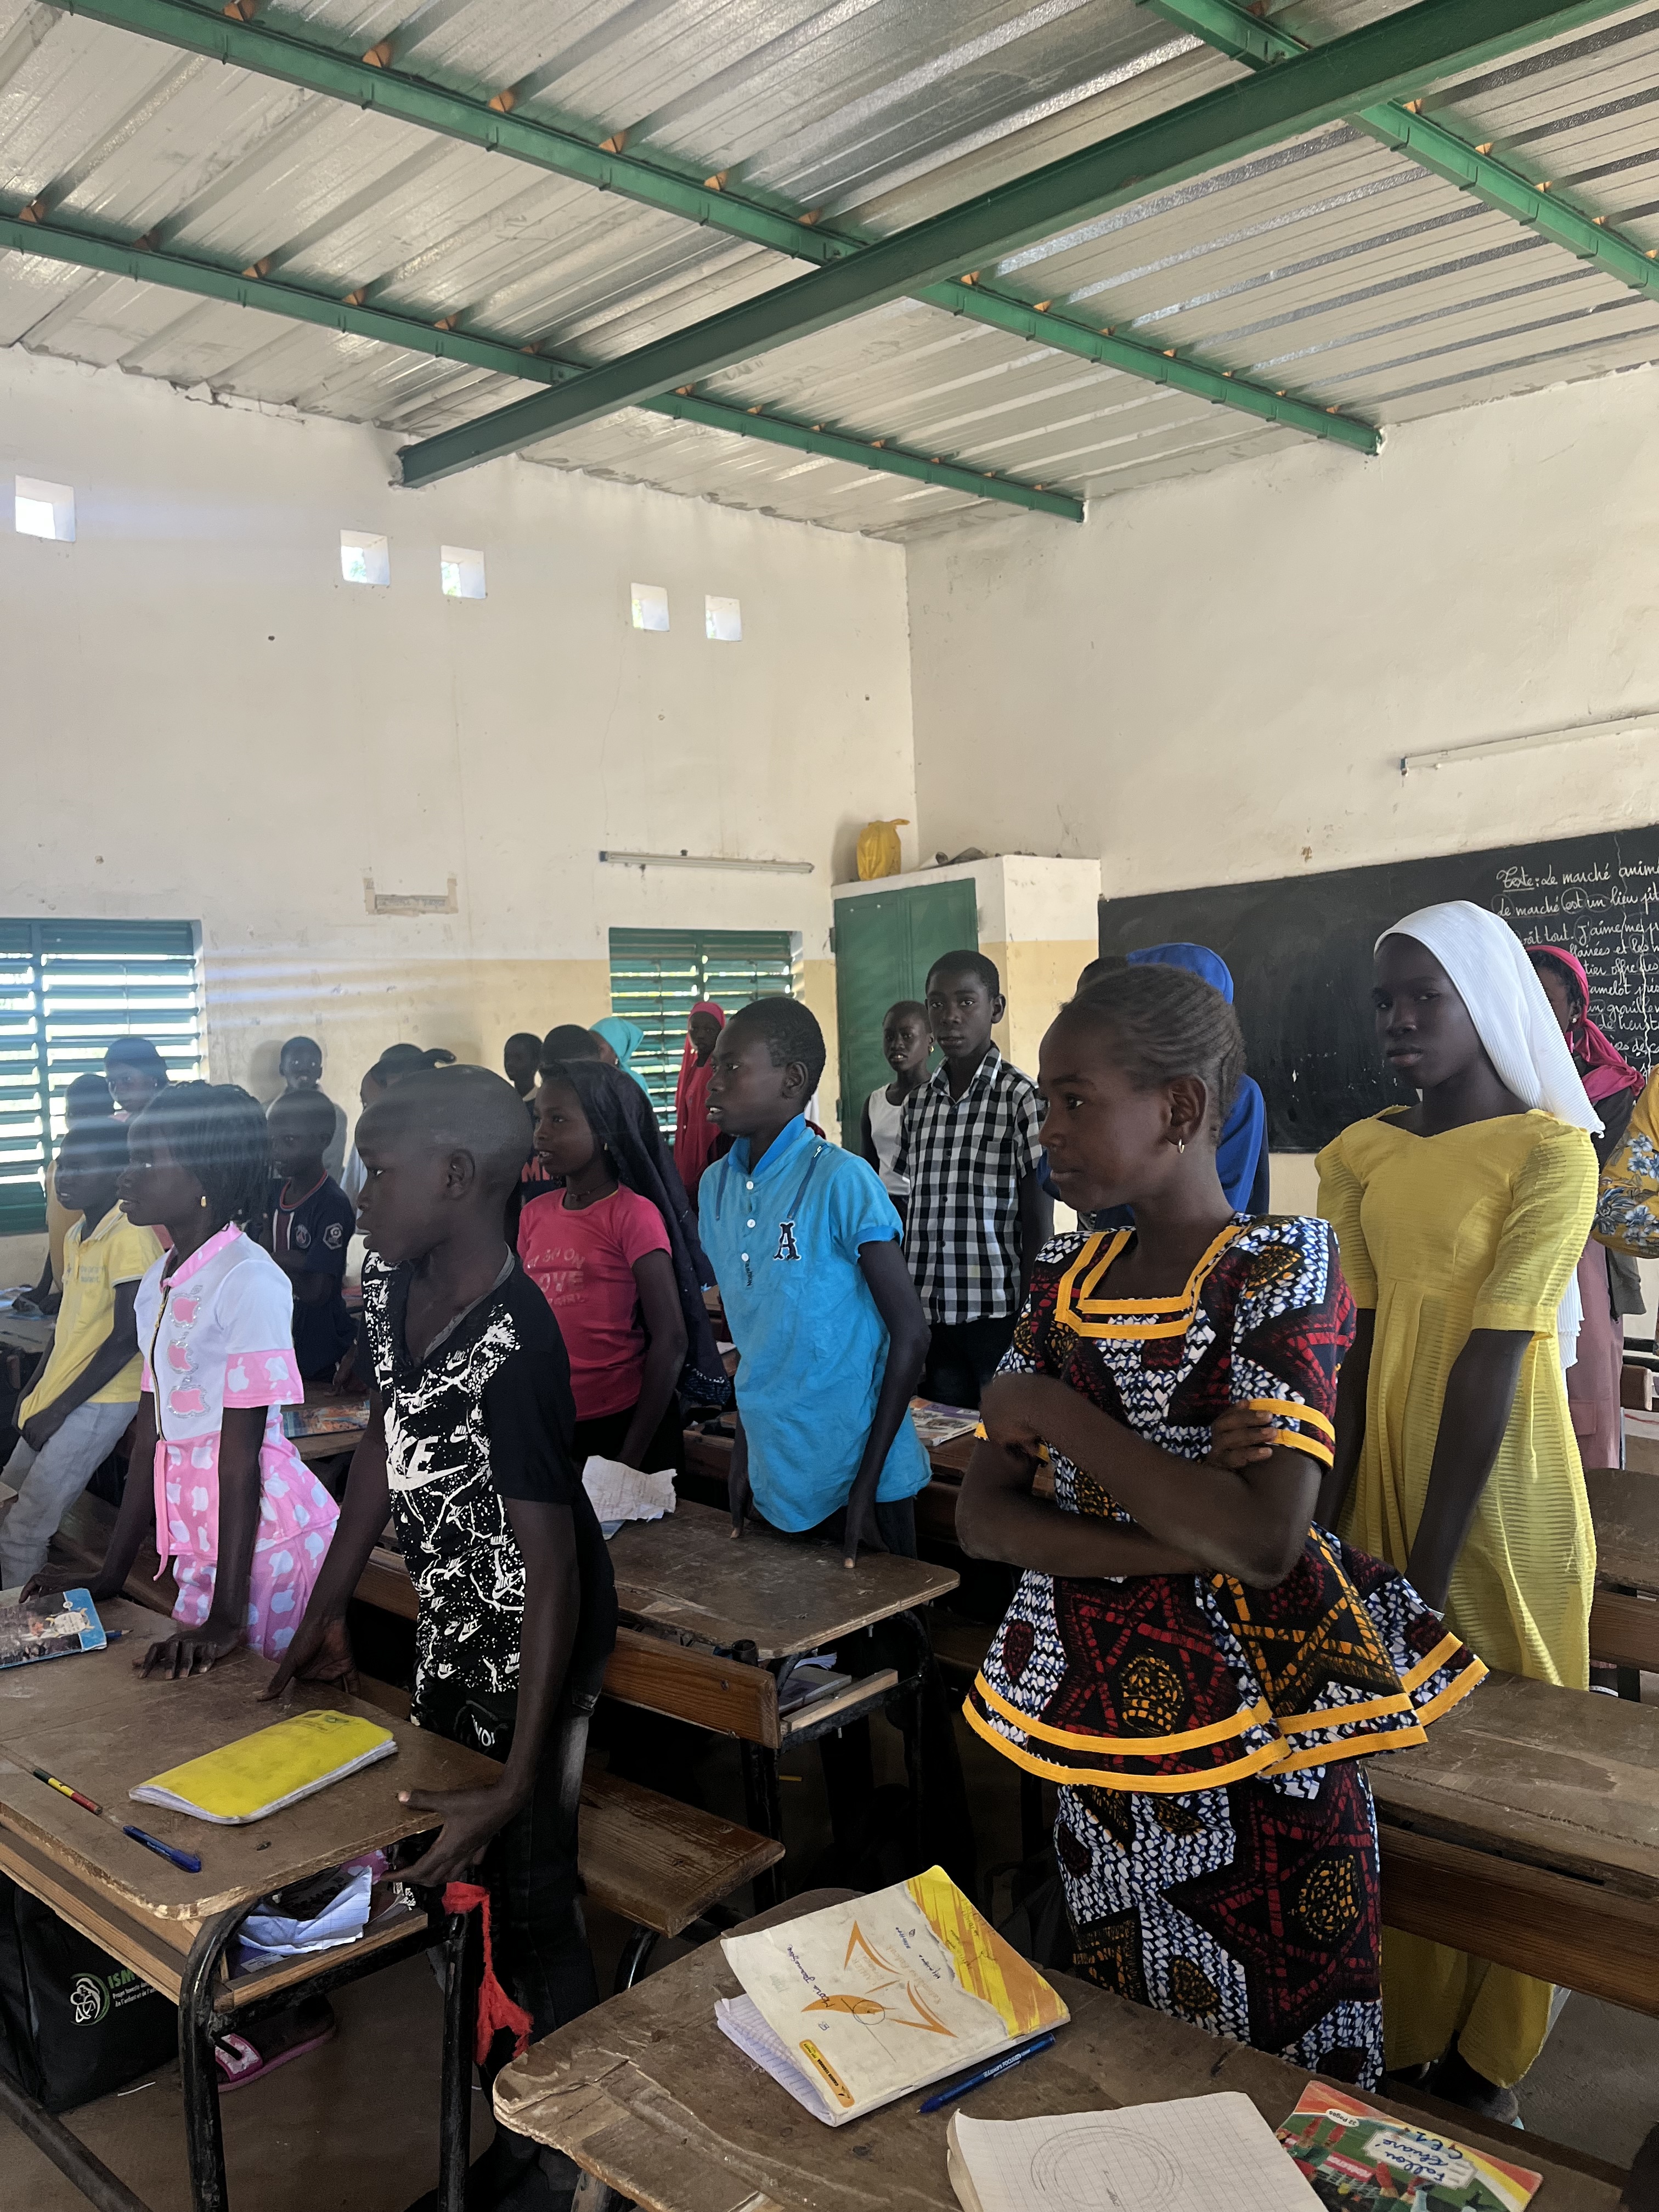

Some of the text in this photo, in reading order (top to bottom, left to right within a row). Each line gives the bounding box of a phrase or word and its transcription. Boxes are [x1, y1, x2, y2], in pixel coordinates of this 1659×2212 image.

[1541, 865, 1558, 885] Le
[1564, 862, 1611, 884] marché
[1516, 895, 1560, 916] marché
[1565, 891, 1583, 909] est
[1587, 899, 1606, 908] un
[1610, 885, 1638, 906] lieu
[1577, 920, 1622, 946] J'aime
[773, 1220, 802, 1261] A
[1328, 2109, 1349, 2123] Pages
